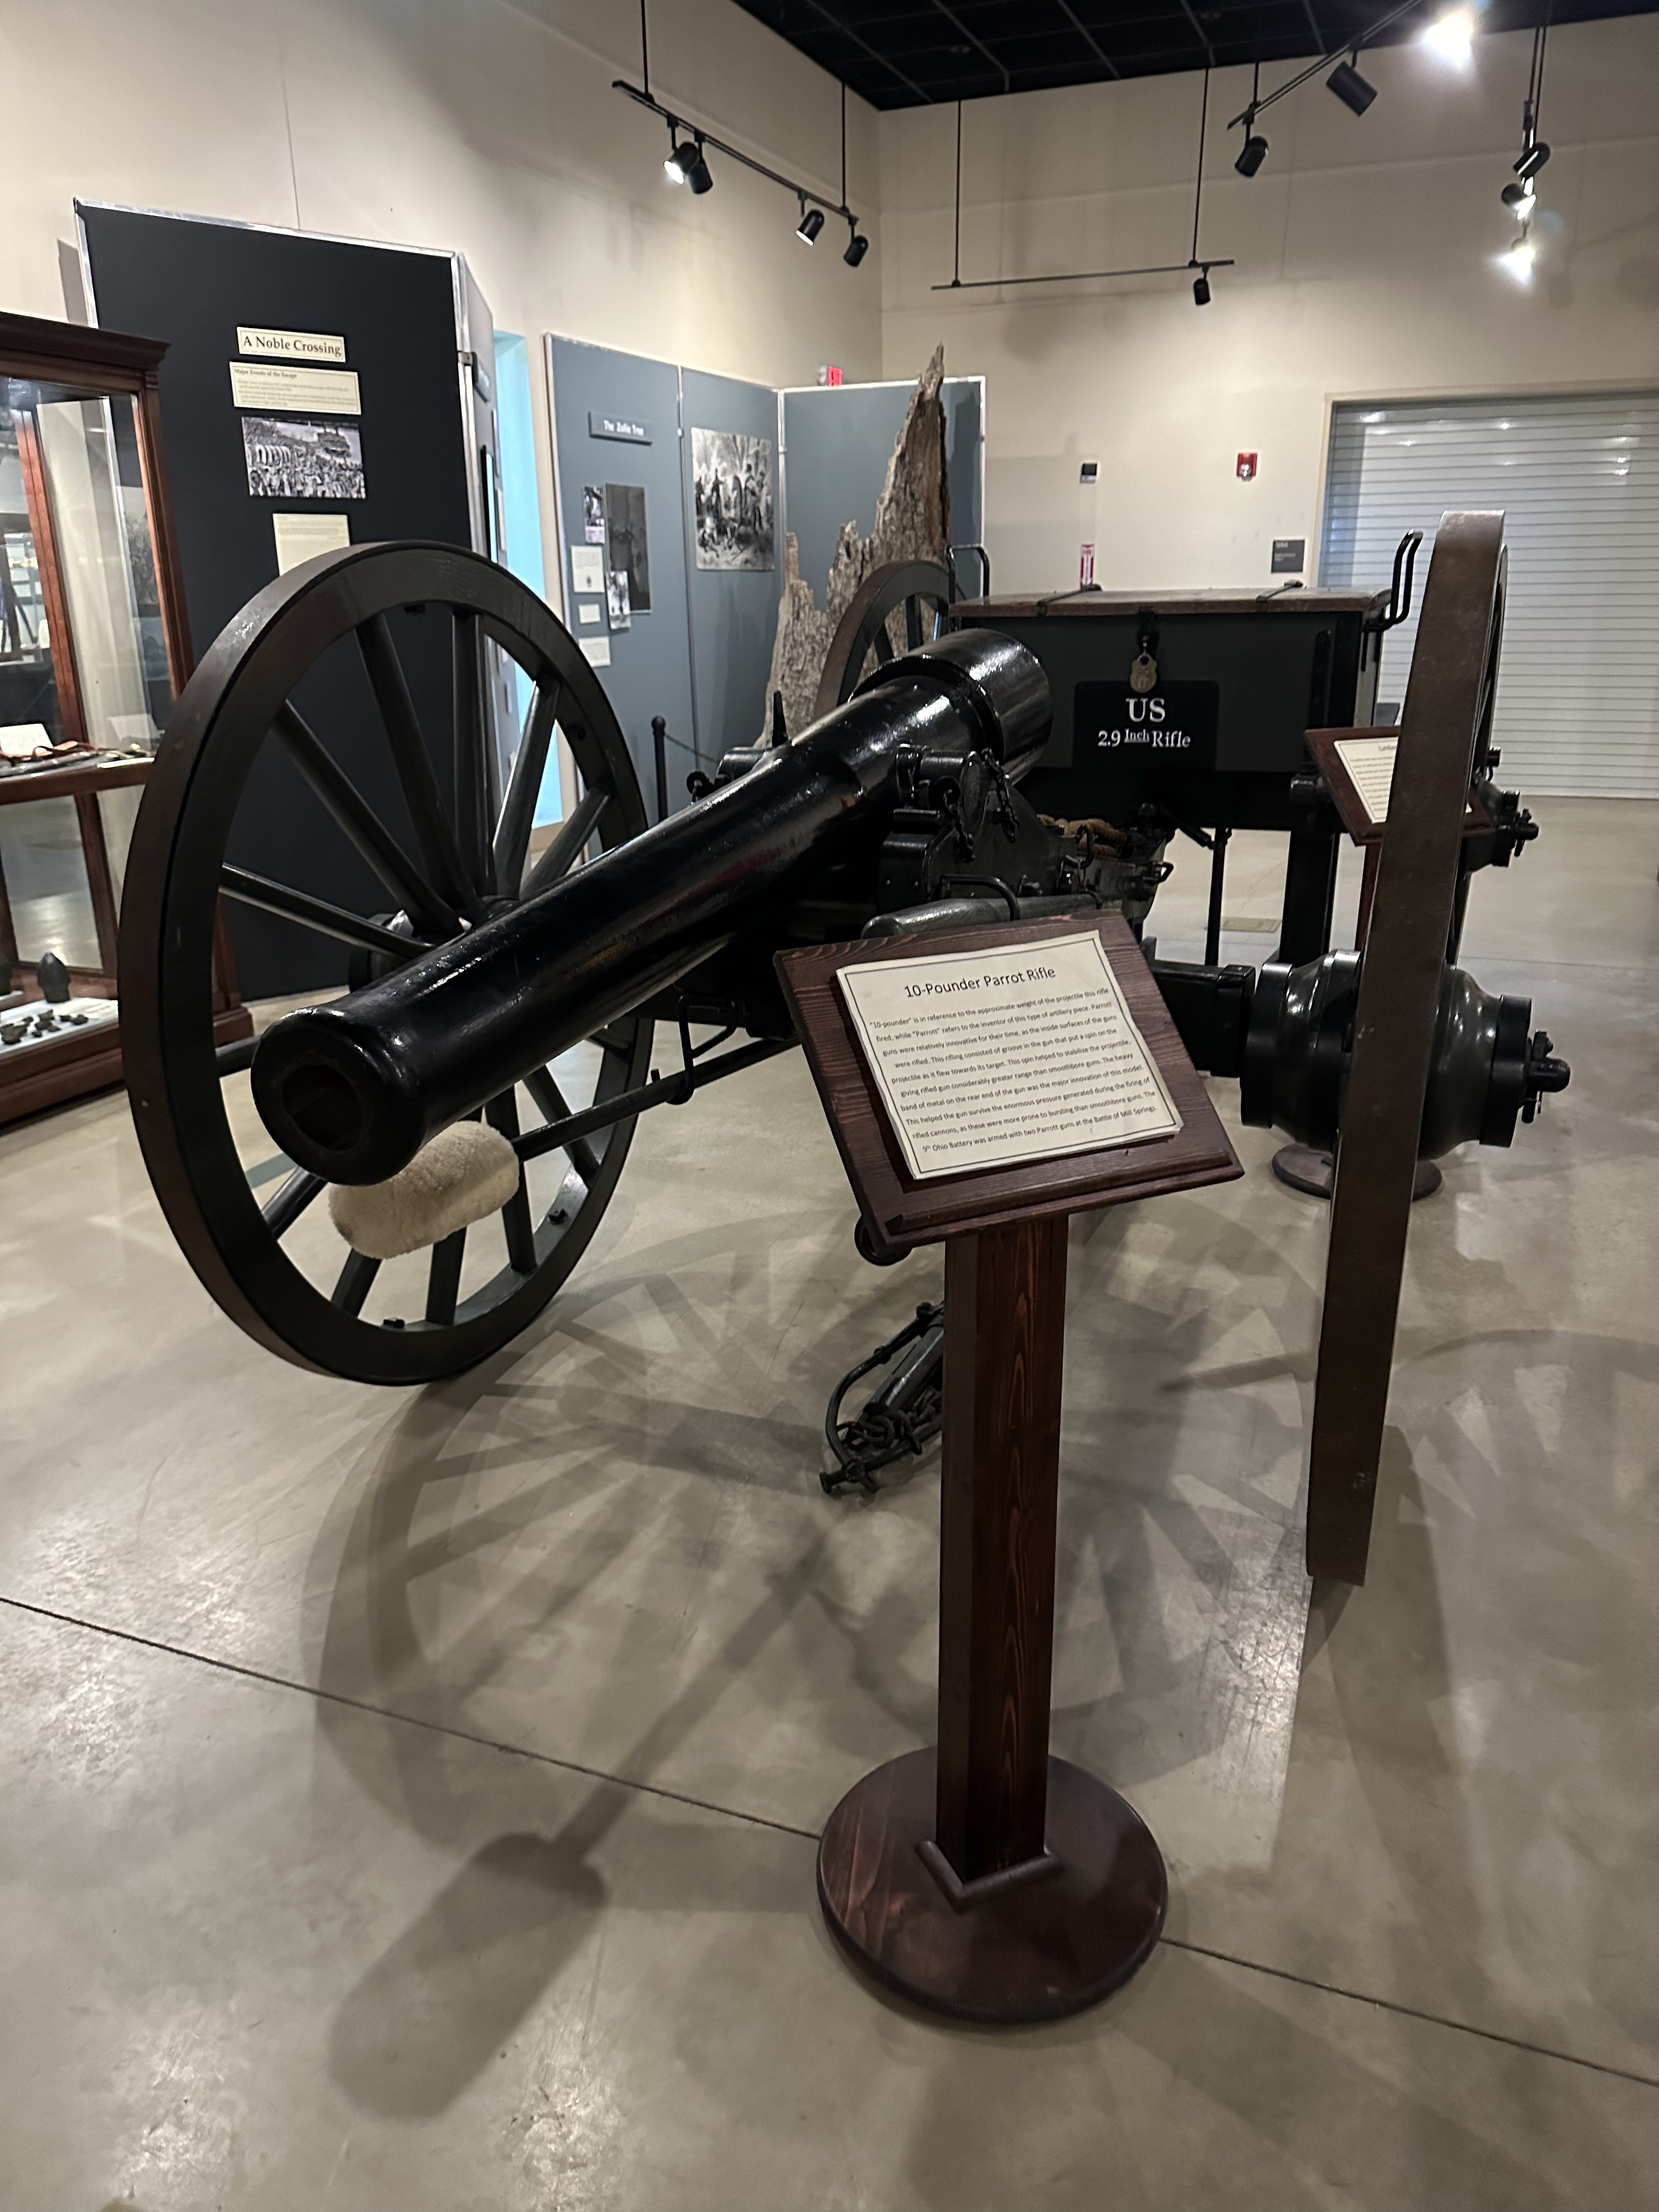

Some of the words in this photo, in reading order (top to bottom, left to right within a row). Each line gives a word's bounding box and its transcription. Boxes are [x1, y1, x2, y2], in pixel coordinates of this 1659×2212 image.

[244, 336, 252, 346] A
[256, 336, 290, 349] Noble
[294, 340, 341, 358] Crossing
[1126, 697, 1166, 722] US
[1098, 730, 1121, 747] 2.9
[1125, 729, 1150, 743] Inch
[1152, 730, 1191, 748] Rifle
[905, 978, 979, 997] 10-Pounder
[983, 972, 1025, 987] Parrot
[1026, 967, 1056, 981] Rifle
[894, 1032, 911, 1040] while
[980, 1019, 1006, 1027] inventor
[1049, 1009, 1072, 1017] artillery
[1091, 1001, 1112, 1010] Parrott
[927, 1013, 957, 1021] reference
[977, 1004, 1015, 1015] approximate
[1056, 993, 1084, 1003] projectile
[882, 1049, 898, 1057] guns
[916, 1042, 944, 1051] relatively
[945, 1037, 978, 1047] innovative
[988, 1032, 1003, 1041] their
[1040, 1024, 1058, 1032] inside
[1084, 1017, 1091, 1025] of
[1103, 1015, 1117, 1023] guns
[964, 1048, 993, 1058] consisted
[994, 1046, 1000, 1054] of
[1001, 1045, 1023, 1054] groove
[1042, 1039, 1054, 1047] gun
[1068, 1034, 1079, 1043] put
[891, 1074, 921, 1085] projectile
[951, 1065, 977, 1075] towards
[1034, 1052, 1056, 1061] helped
[900, 1089, 920, 1098] giving
[920, 1085, 937, 1093] rifled
[951, 1077, 990, 1089] considerably
[991, 1074, 1013, 1084] greater
[1048, 1062, 1085, 1073] smoothbore
[1114, 1053, 1133, 1061] heavy
[900, 1103, 917, 1111] band
[927, 1098, 945, 1108] metal
[981, 1091, 994, 1099] end
[994, 1089, 1001, 1097] of
[1014, 1087, 1026, 1095] gun
[919, 1114, 943, 1124] helped
[955, 1111, 968, 1119] gun
[968, 1107, 991, 1116] survive
[1003, 1100, 1035, 1110] enormous
[1035, 1095, 1062, 1105] pressure
[1063, 1088, 1093, 1099] generated
[1094, 1085, 1115, 1094] during
[1143, 1076, 1150, 1084] of
[912, 1131, 929, 1139] rifled
[1021, 1114, 1039, 1122] prone
[1047, 1107, 1074, 1117] bursting
[1089, 1098, 1126, 1109] smoothbore
[949, 1140, 972, 1148] Battery
[987, 1132, 1008, 1142] armed
[1008, 1130, 1023, 1138] with
[1036, 1124, 1059, 1133] Parrott
[1059, 1122, 1075, 1131] guns
[1093, 1114, 1112, 1123] Battle
[1113, 1111, 1119, 1119] of
